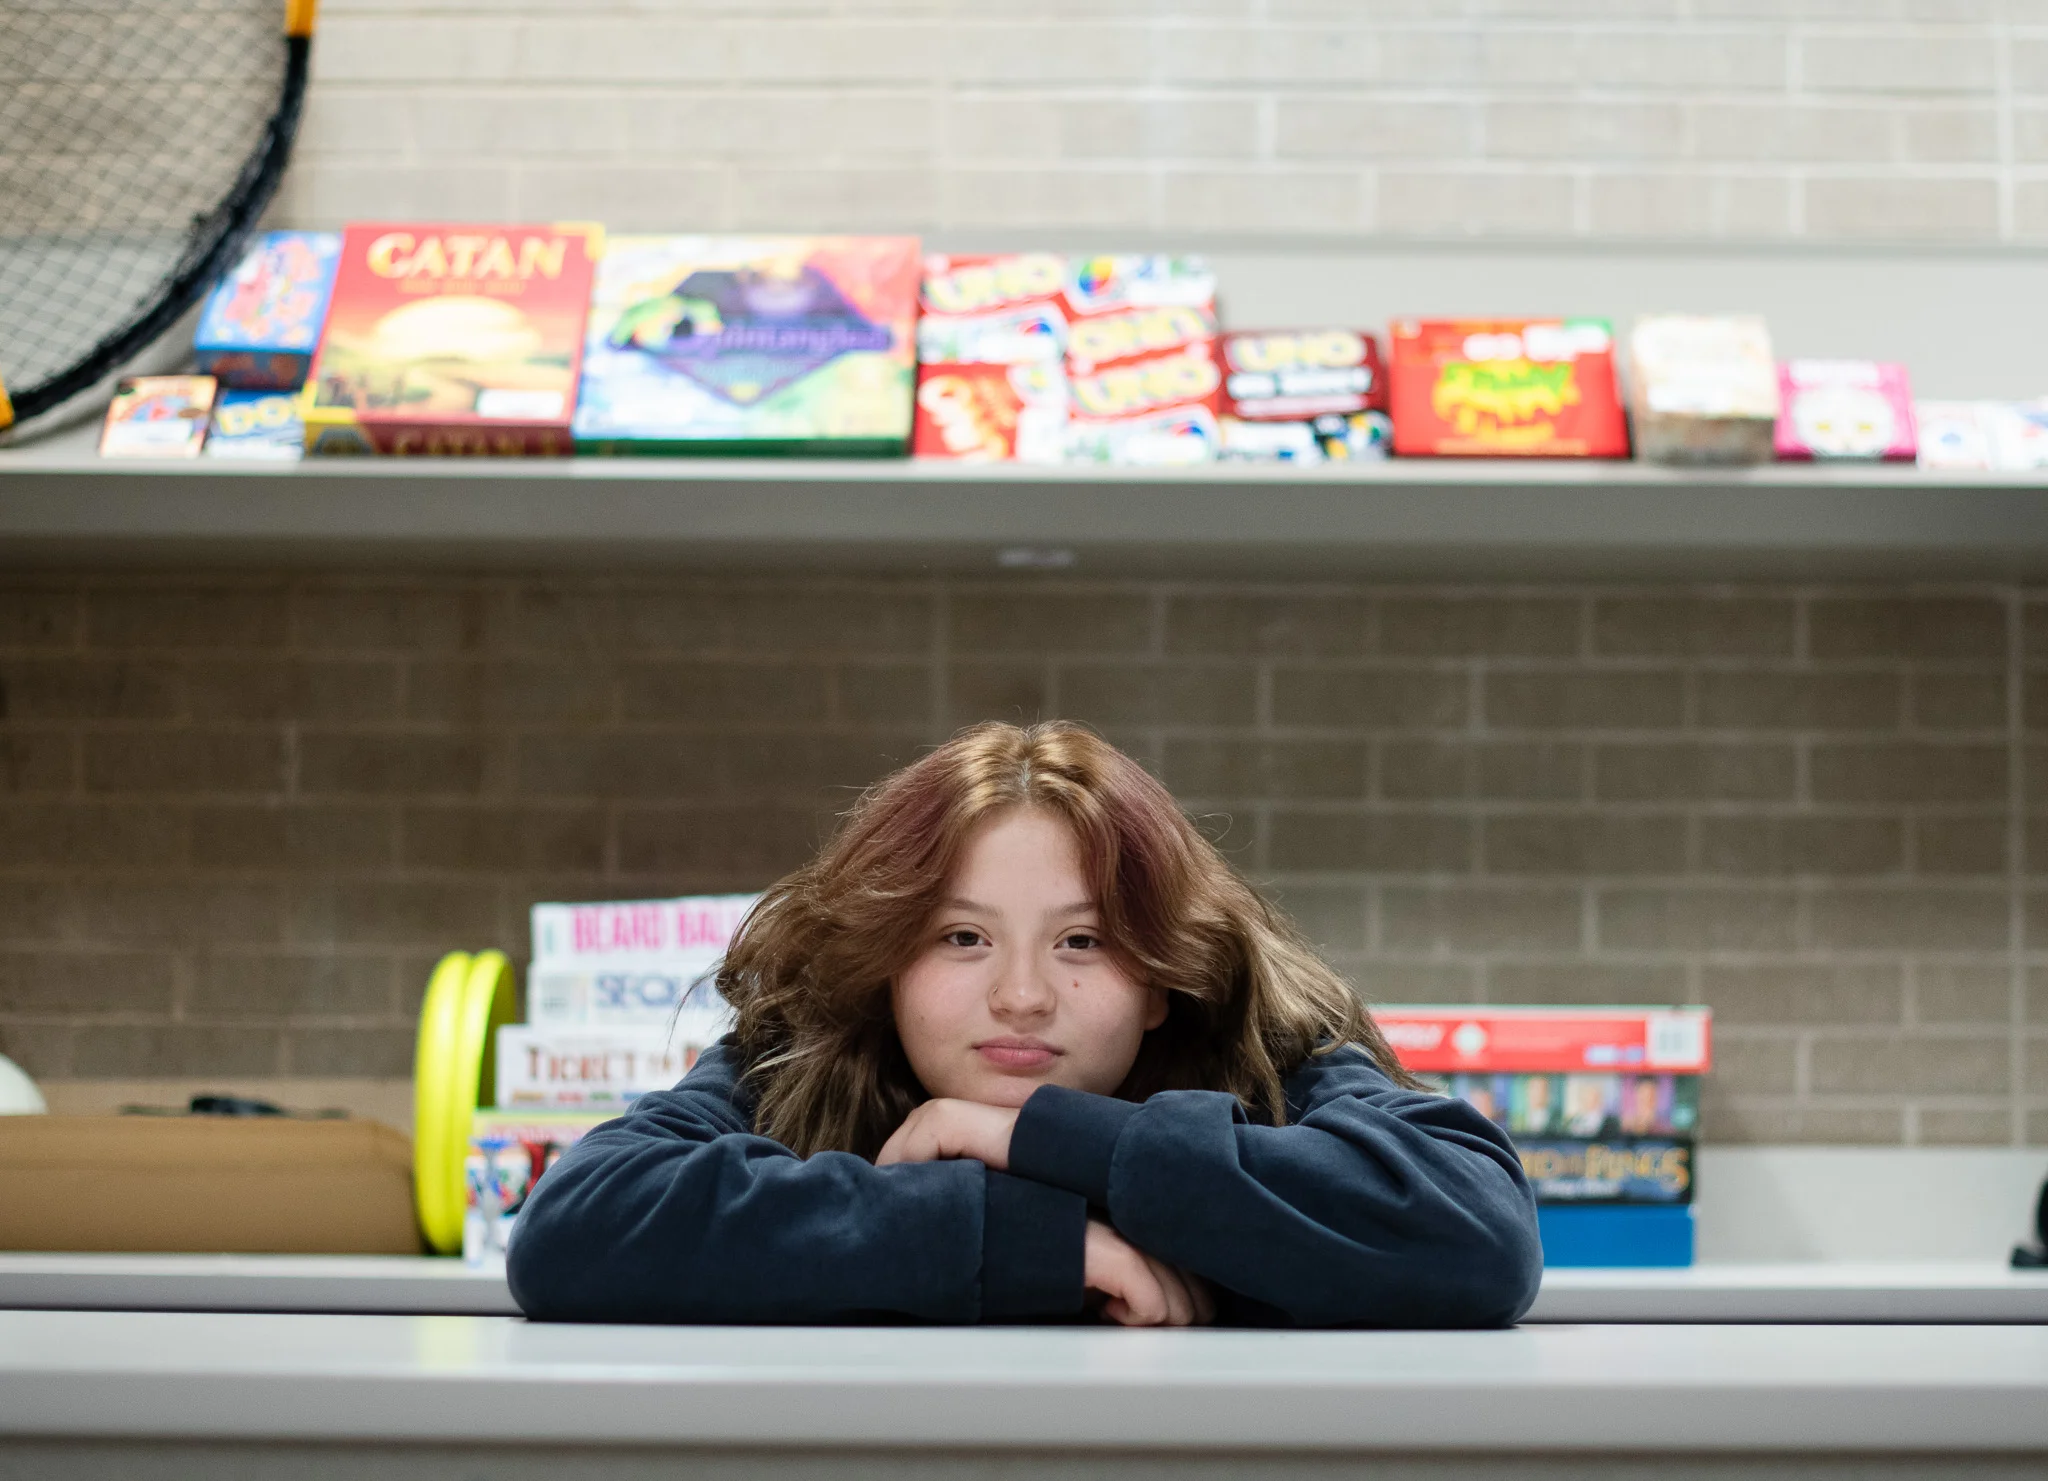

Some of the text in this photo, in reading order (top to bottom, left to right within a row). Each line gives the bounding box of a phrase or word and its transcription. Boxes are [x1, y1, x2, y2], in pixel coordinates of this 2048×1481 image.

[366, 232, 568, 281] CATAN
[1228, 331, 1367, 370] UNO
[1072, 354, 1218, 415] UNO
